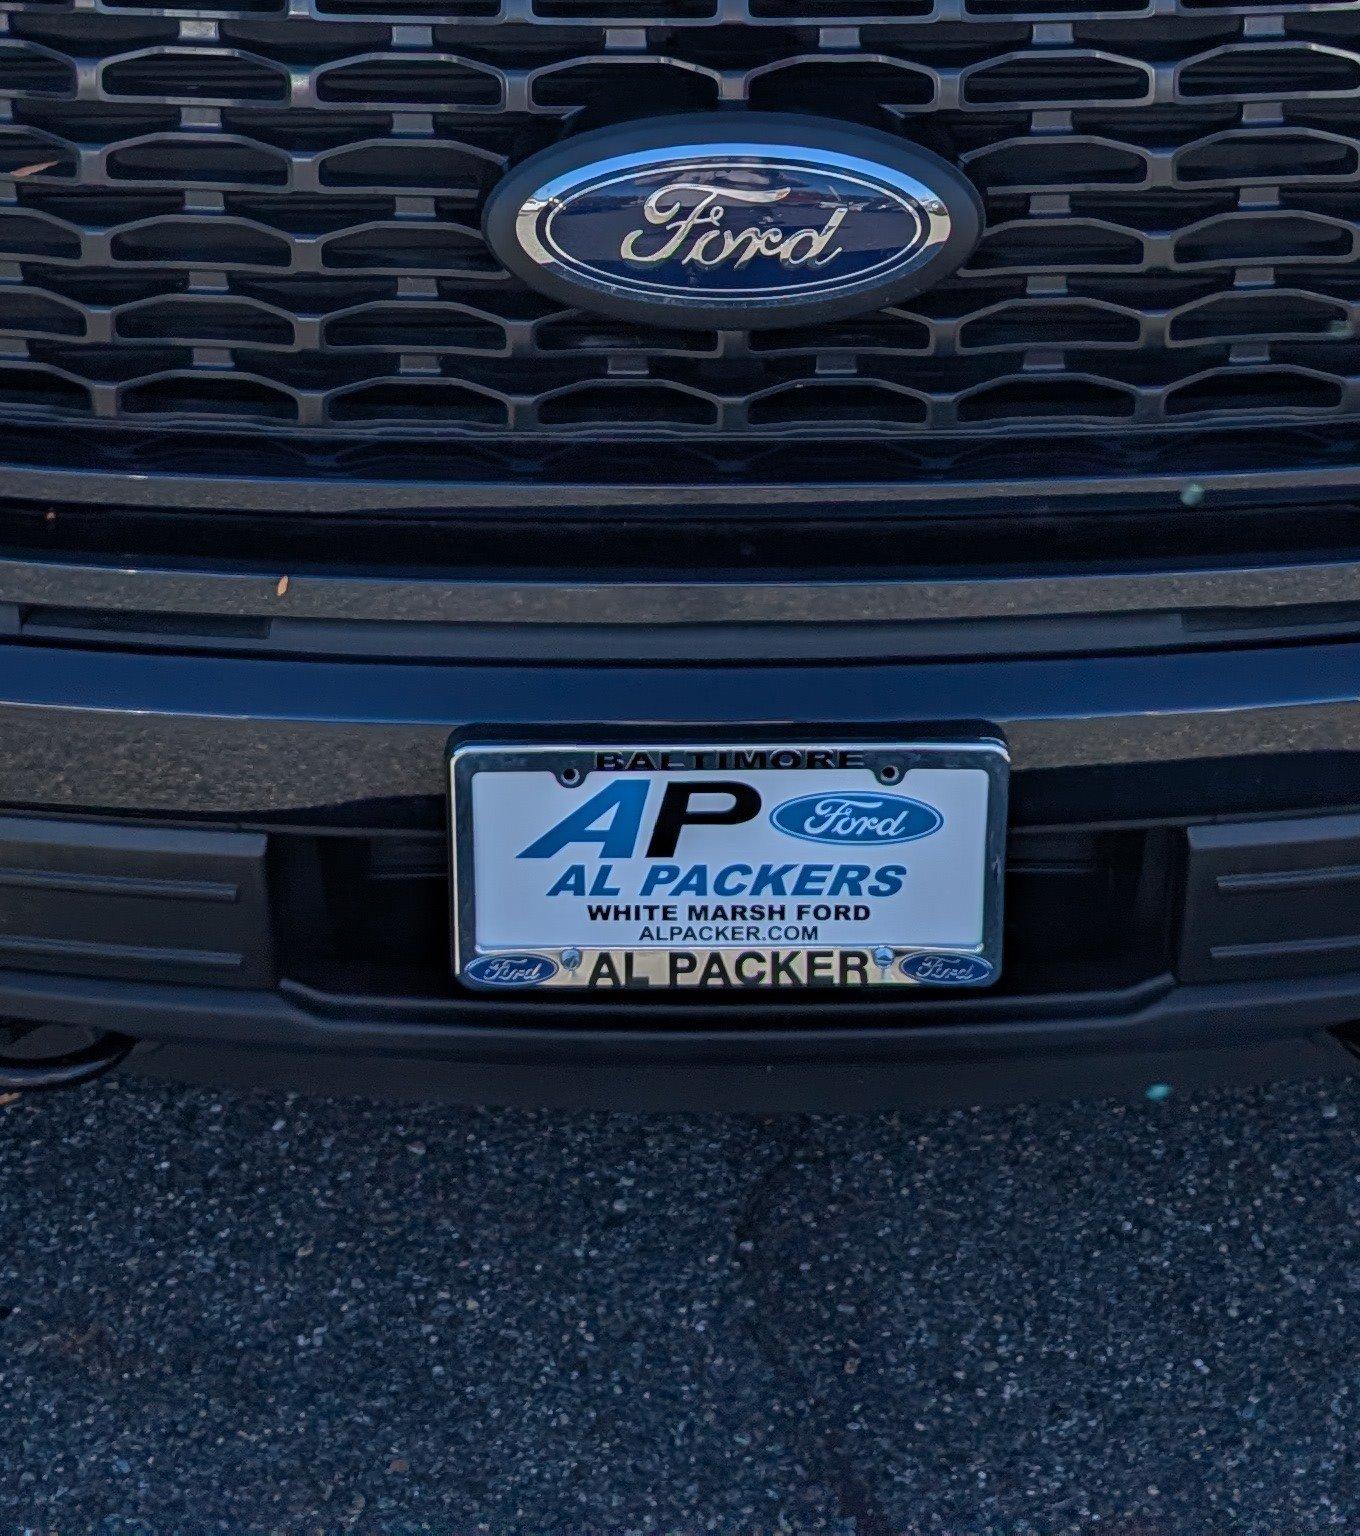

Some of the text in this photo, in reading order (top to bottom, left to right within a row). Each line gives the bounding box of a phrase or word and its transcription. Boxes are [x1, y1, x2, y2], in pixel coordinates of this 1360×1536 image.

[620, 183, 848, 270] Ford
[593, 749, 865, 770] BALTIMORE
[515, 779, 762, 858] AP
[803, 798, 910, 837] Ford
[546, 864, 908, 897] AL PACKERS
[587, 904, 871, 922] WHITE MARSH FORD
[638, 925, 819, 942] ALPACKER.COM
[482, 958, 543, 982] Ford
[588, 950, 870, 989] AL PACKER
[913, 957, 975, 982] Ford
